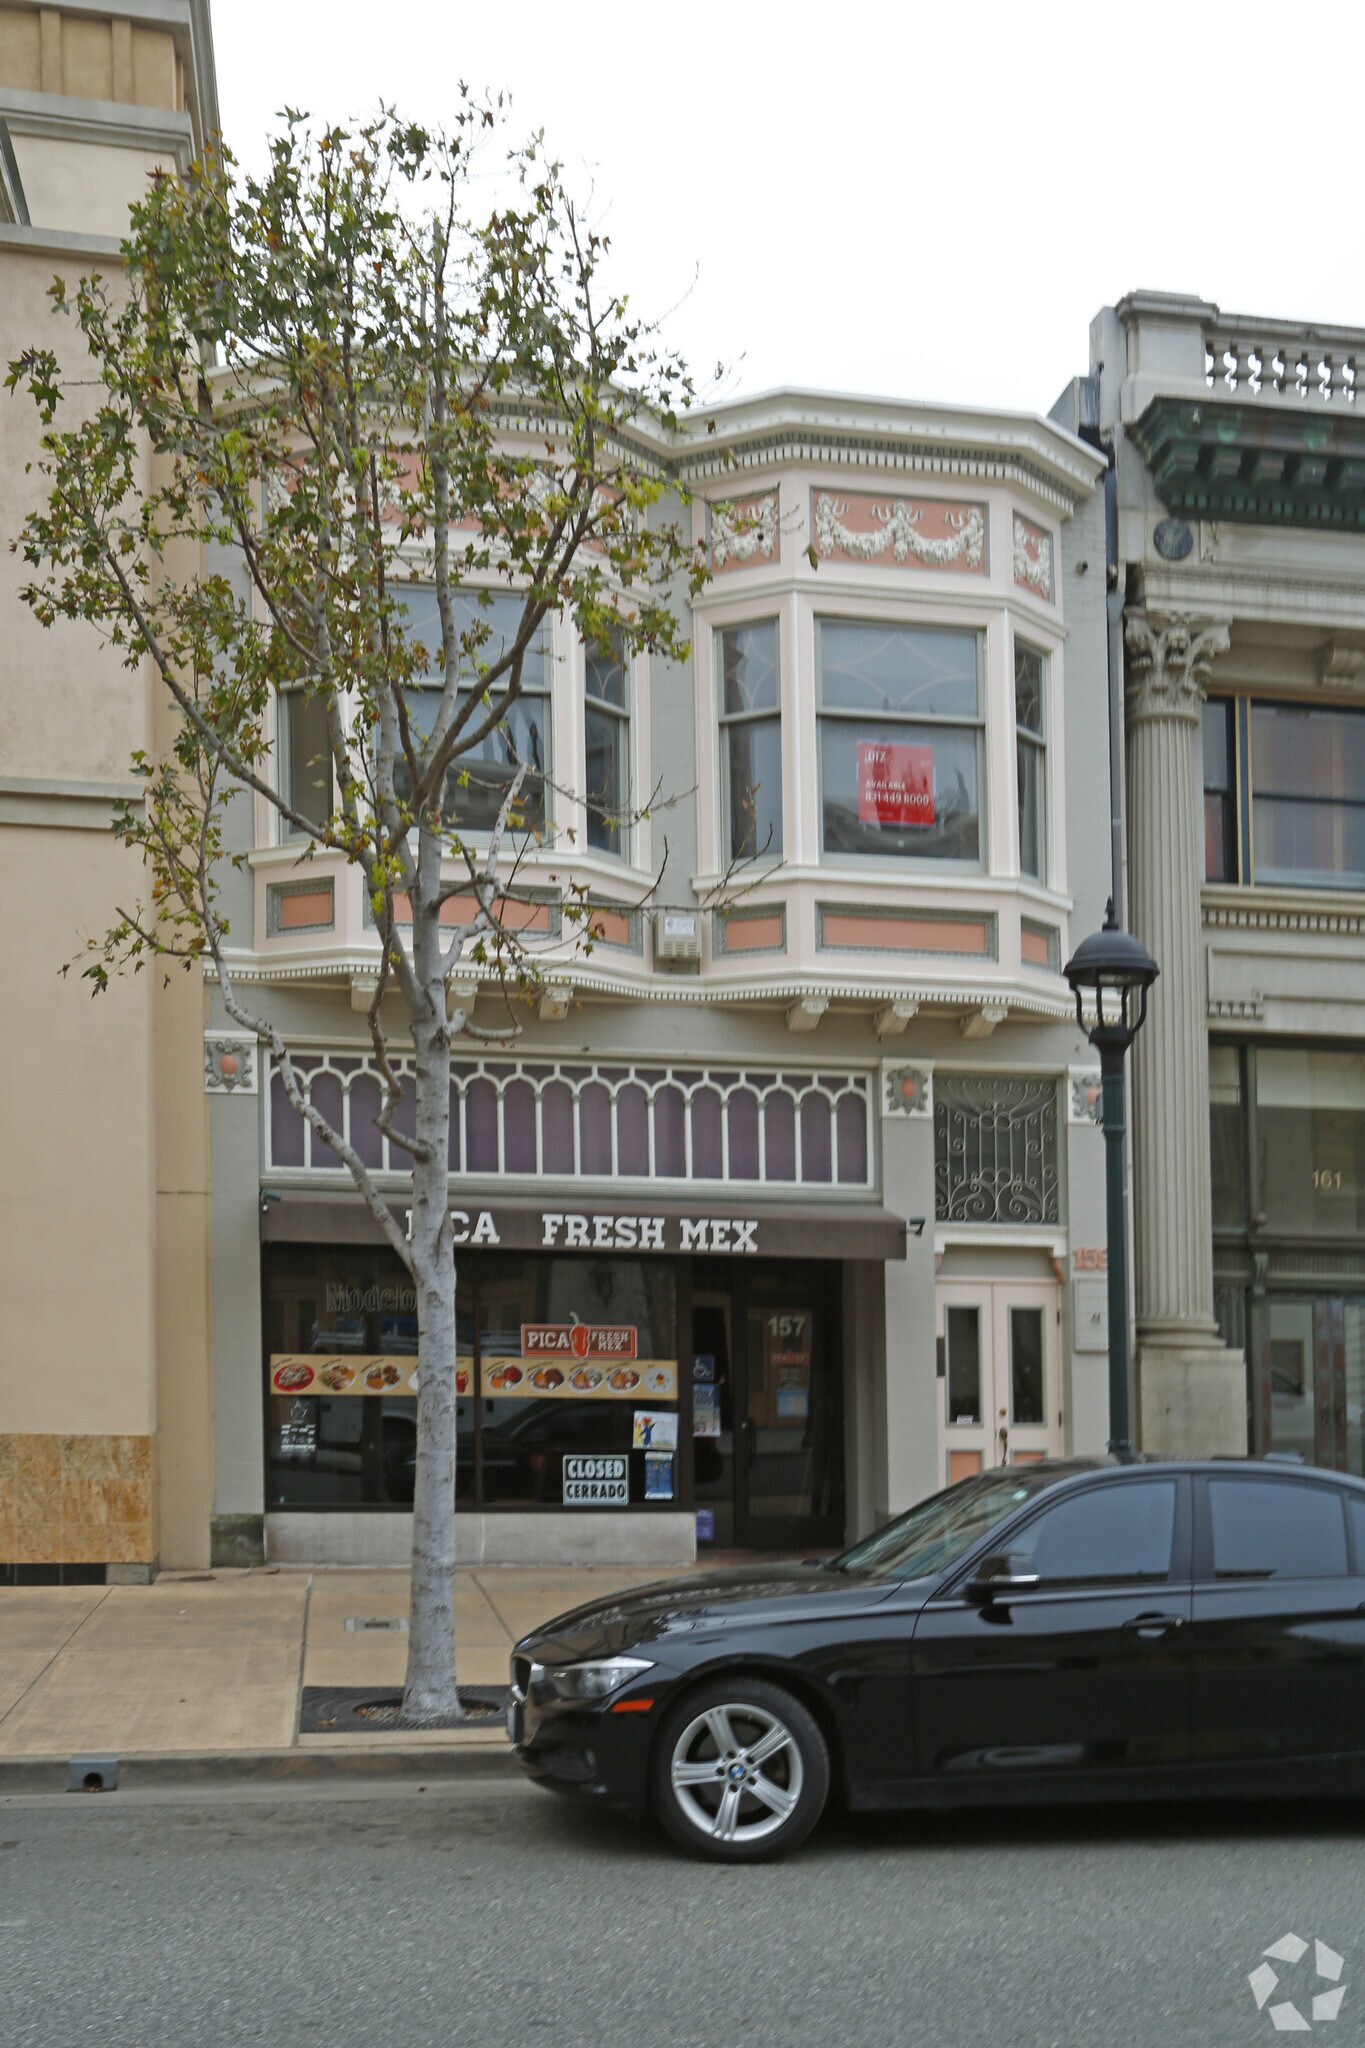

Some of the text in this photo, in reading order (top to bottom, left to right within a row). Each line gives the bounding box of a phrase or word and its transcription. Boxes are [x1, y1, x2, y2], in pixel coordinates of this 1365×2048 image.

[1311, 1169, 1342, 1190] 161
[542, 1213, 665, 1250] FRESH
[679, 1218, 759, 1252] MEX
[768, 1316, 806, 1337] 157
[527, 1331, 570, 1349] PICA
[591, 1331, 629, 1343] FRESH
[567, 1460, 625, 1479] CLOSED
[565, 1484, 626, 1499] CERRADO
